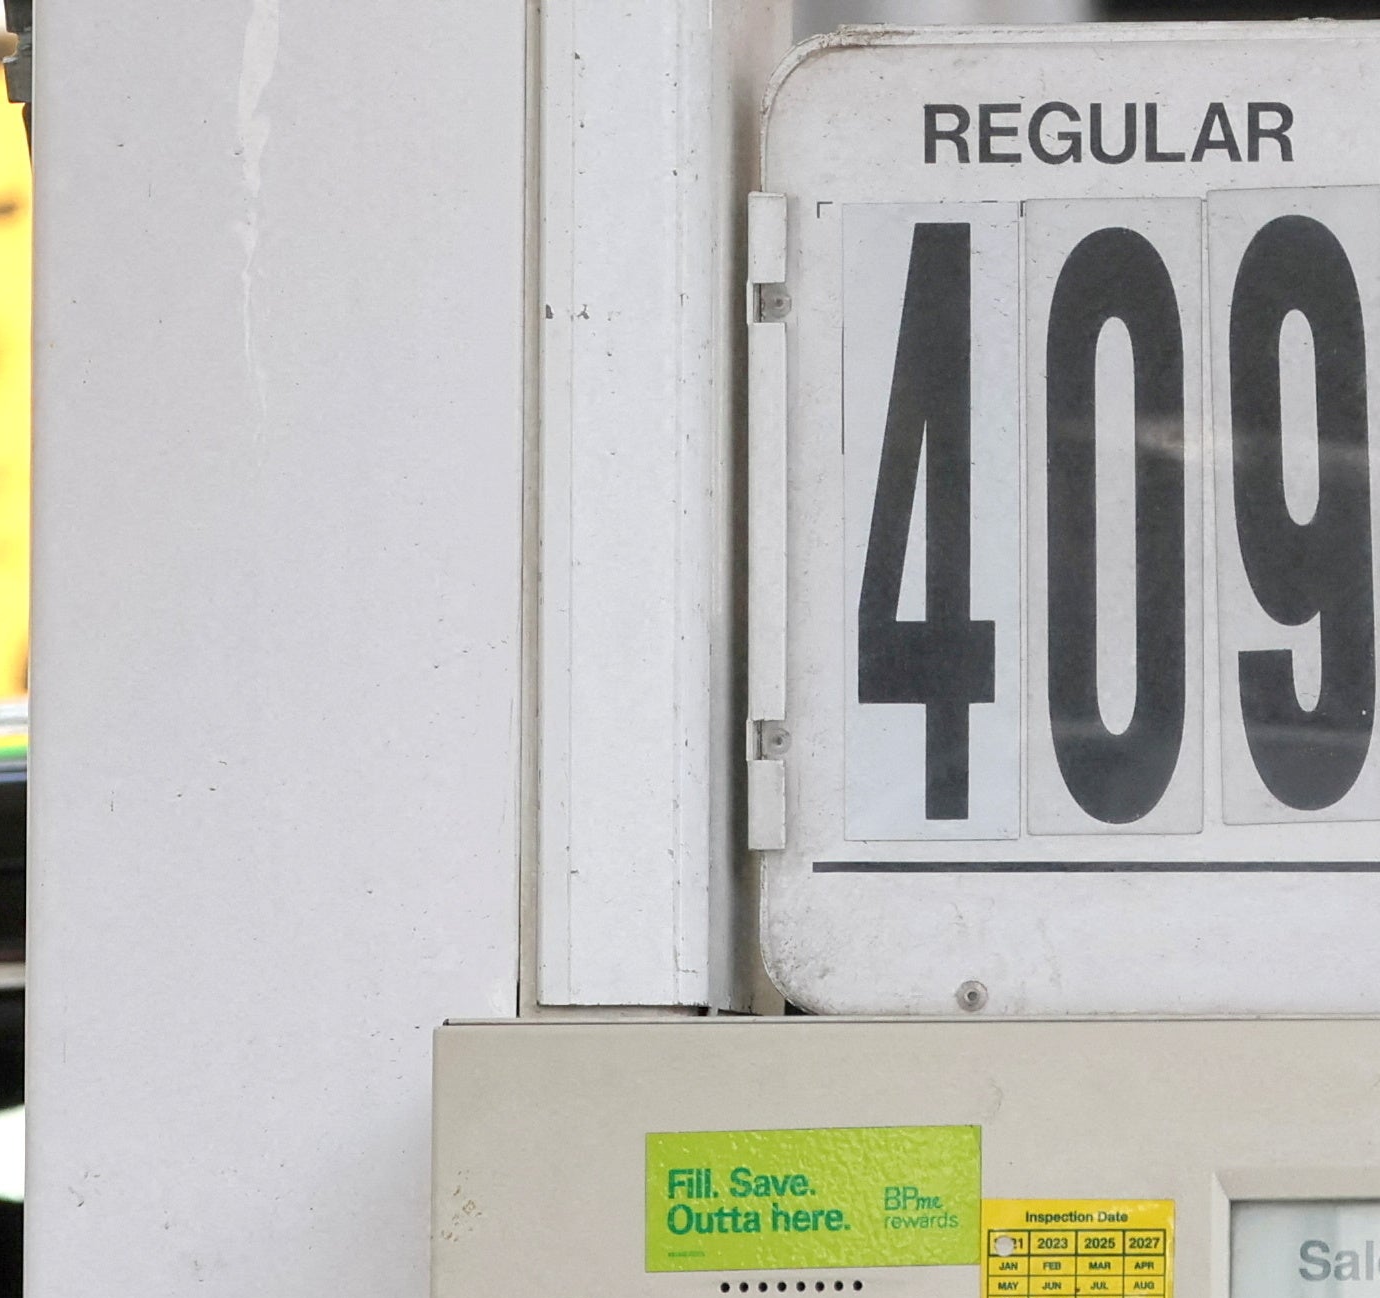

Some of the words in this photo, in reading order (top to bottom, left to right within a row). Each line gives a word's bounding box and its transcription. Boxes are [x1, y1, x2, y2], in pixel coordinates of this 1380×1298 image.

[923, 101, 1294, 164] REGULAR
[668, 1168, 719, 1199] Fill.
[730, 1167, 816, 1197] Save.
[667, 1204, 761, 1235] Outta
[772, 1203, 851, 1232] here.
[884, 1212, 959, 1230] rewards
[1025, 1211, 1094, 1224] Inspection
[1097, 1211, 1128, 1222] Date
[1037, 1238, 1068, 1249] 2023
[1084, 1238, 1116, 1249] 2025
[1129, 1238, 1160, 1249] 2027
[999, 1262, 1018, 1271] JAN
[1043, 1262, 1061, 1270] FEB
[1089, 1262, 1111, 1270] MAR
[1134, 1262, 1154, 1270] APR
[998, 1282, 1018, 1290] MAY
[1042, 1282, 1062, 1290] JUN
[1091, 1282, 1108, 1290] JUL
[1133, 1282, 1154, 1290] AUG
